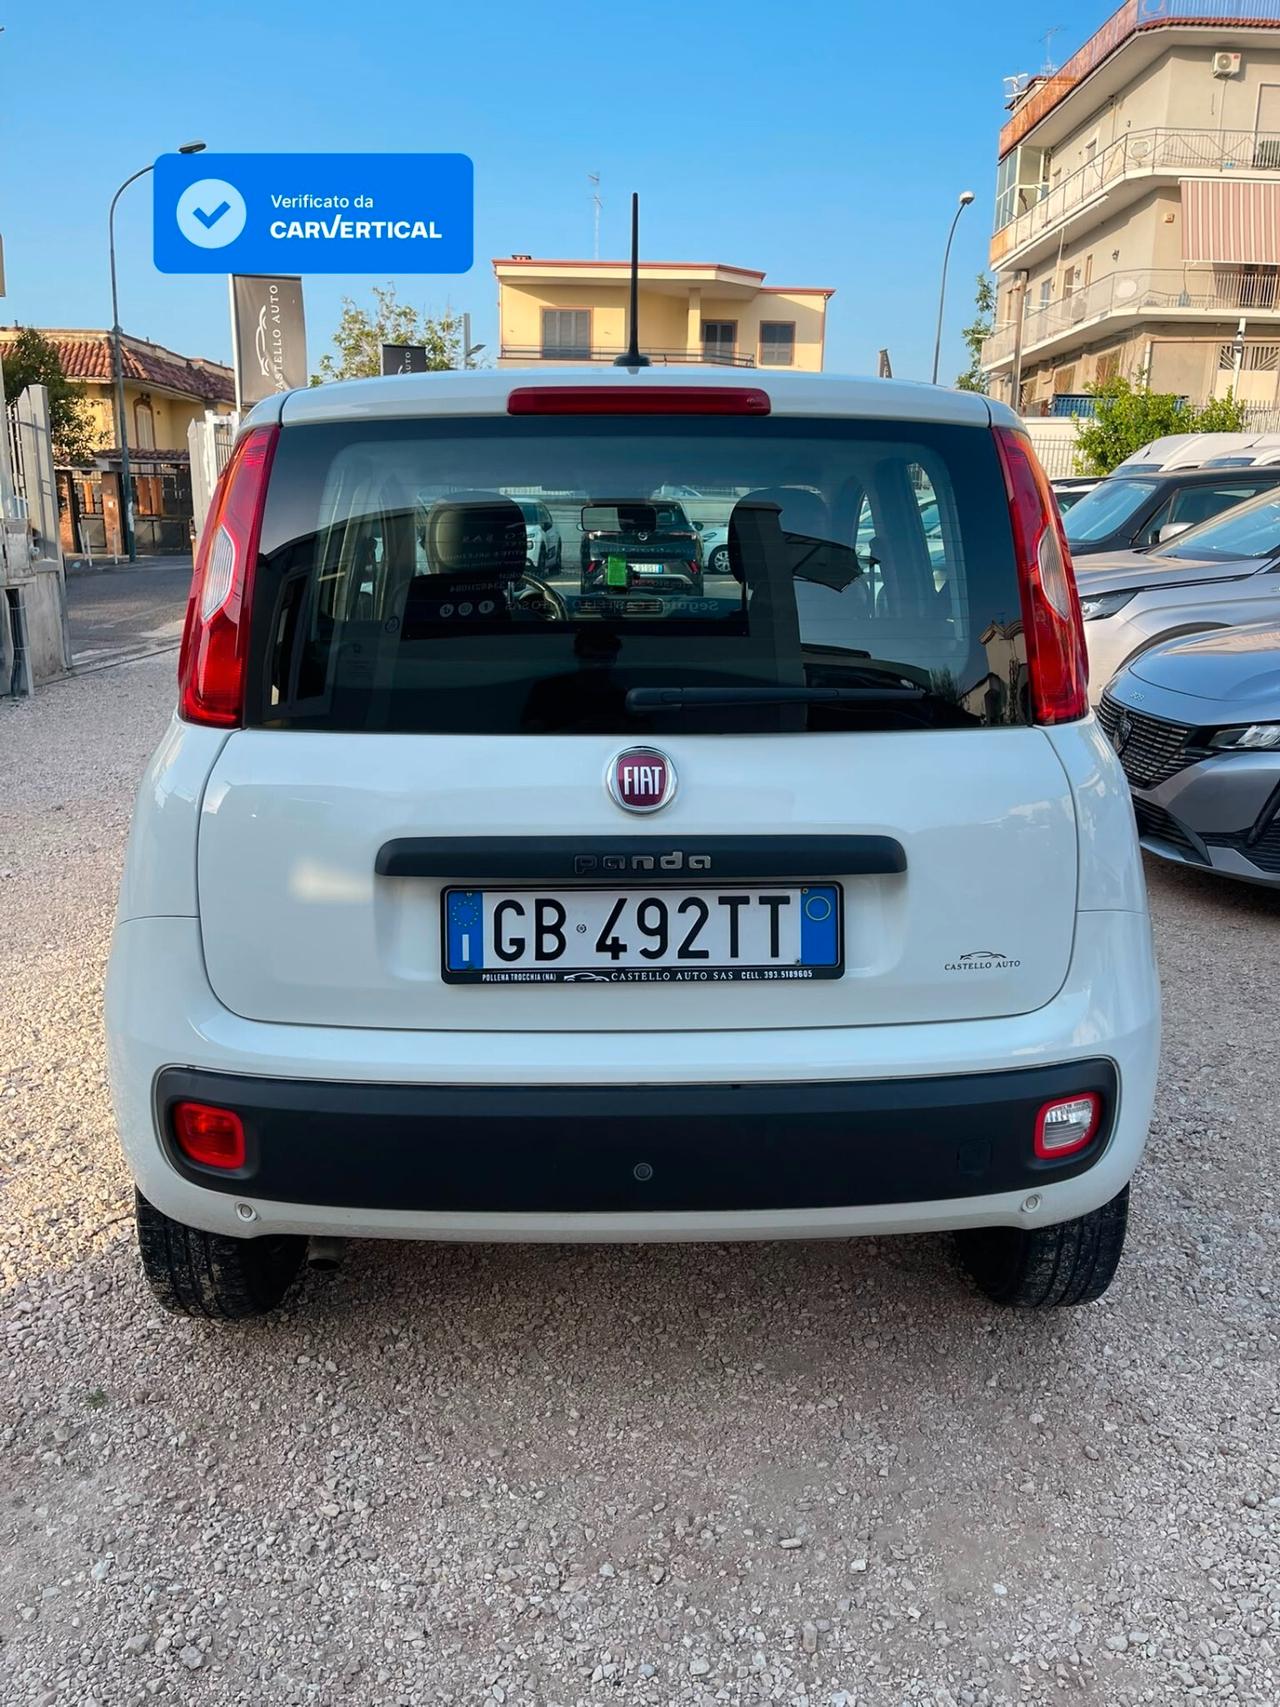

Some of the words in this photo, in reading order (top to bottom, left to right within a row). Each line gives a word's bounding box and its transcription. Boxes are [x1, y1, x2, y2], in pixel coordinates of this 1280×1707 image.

[269, 284, 281, 324] AUTO
[273, 328, 284, 394] ASTELLO
[404, 351, 412, 374] UTO
[623, 766, 662, 795] FIAT
[574, 851, 712, 874] panda
[482, 973, 510, 982] POLLENA
[511, 973, 541, 981] TROCCHIA
[542, 972, 557, 982] (NA)
[611, 972, 670, 982] CASTELLO
[676, 971, 708, 981] AUTO
[713, 971, 734, 980] SAS
[741, 971, 762, 980] CELL.
[944, 961, 992, 971] CASTELLO
[995, 960, 1021, 969] AUTO
